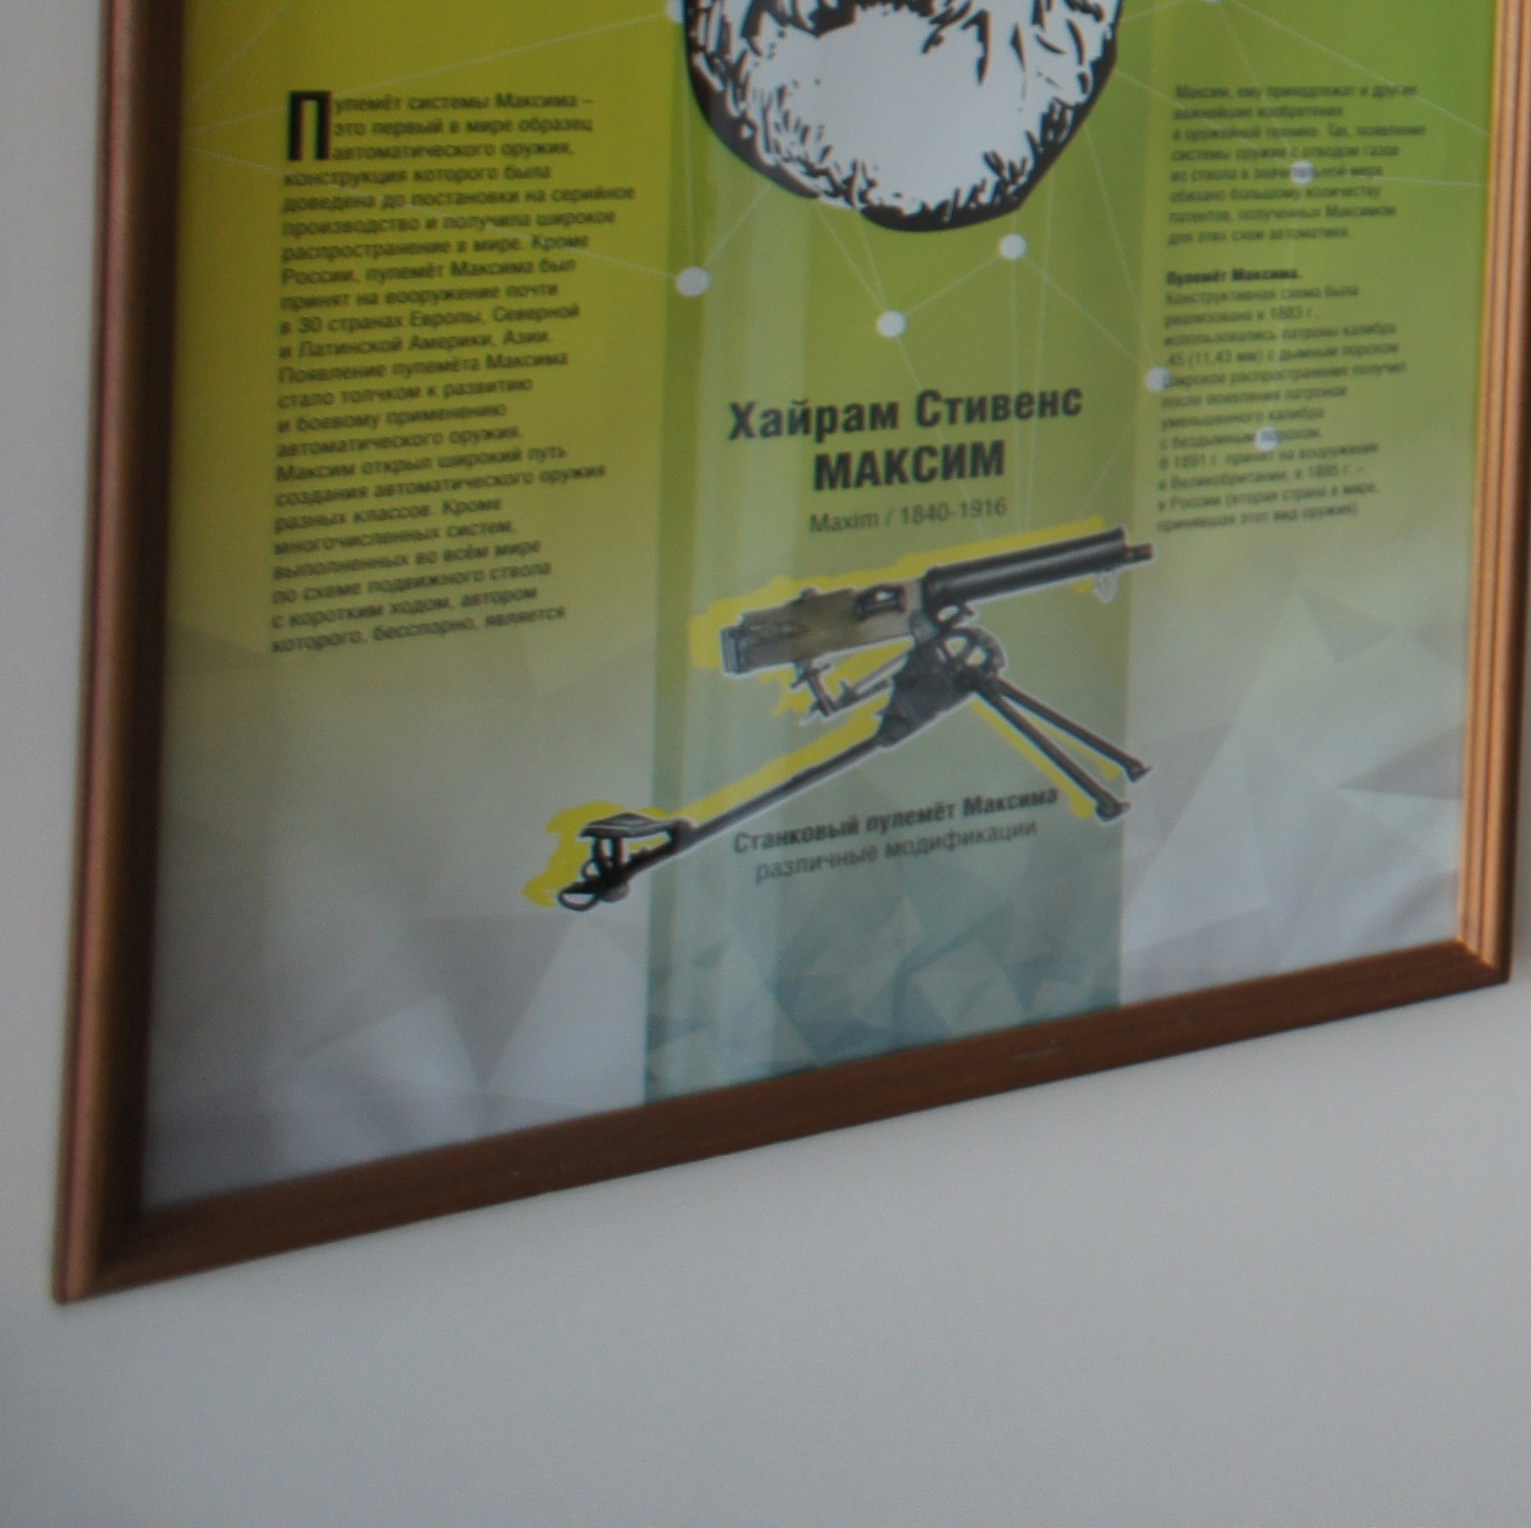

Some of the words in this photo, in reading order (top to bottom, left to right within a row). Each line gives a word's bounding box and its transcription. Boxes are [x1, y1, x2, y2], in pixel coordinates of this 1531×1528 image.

[727, 400, 900, 442] Хайрам
[916, 388, 1083, 428] Стивенс
[813, 441, 1006, 491] МАКСИМ
[809, 510, 879, 534] Maxim
[900, 498, 1007, 525] 1840-1916
[733, 816, 859, 853] Станковый
[867, 803, 955, 835] пулемёт
[962, 787, 1058, 818] Максима
[755, 843, 878, 884] различные
[885, 819, 1038, 860] модификации
